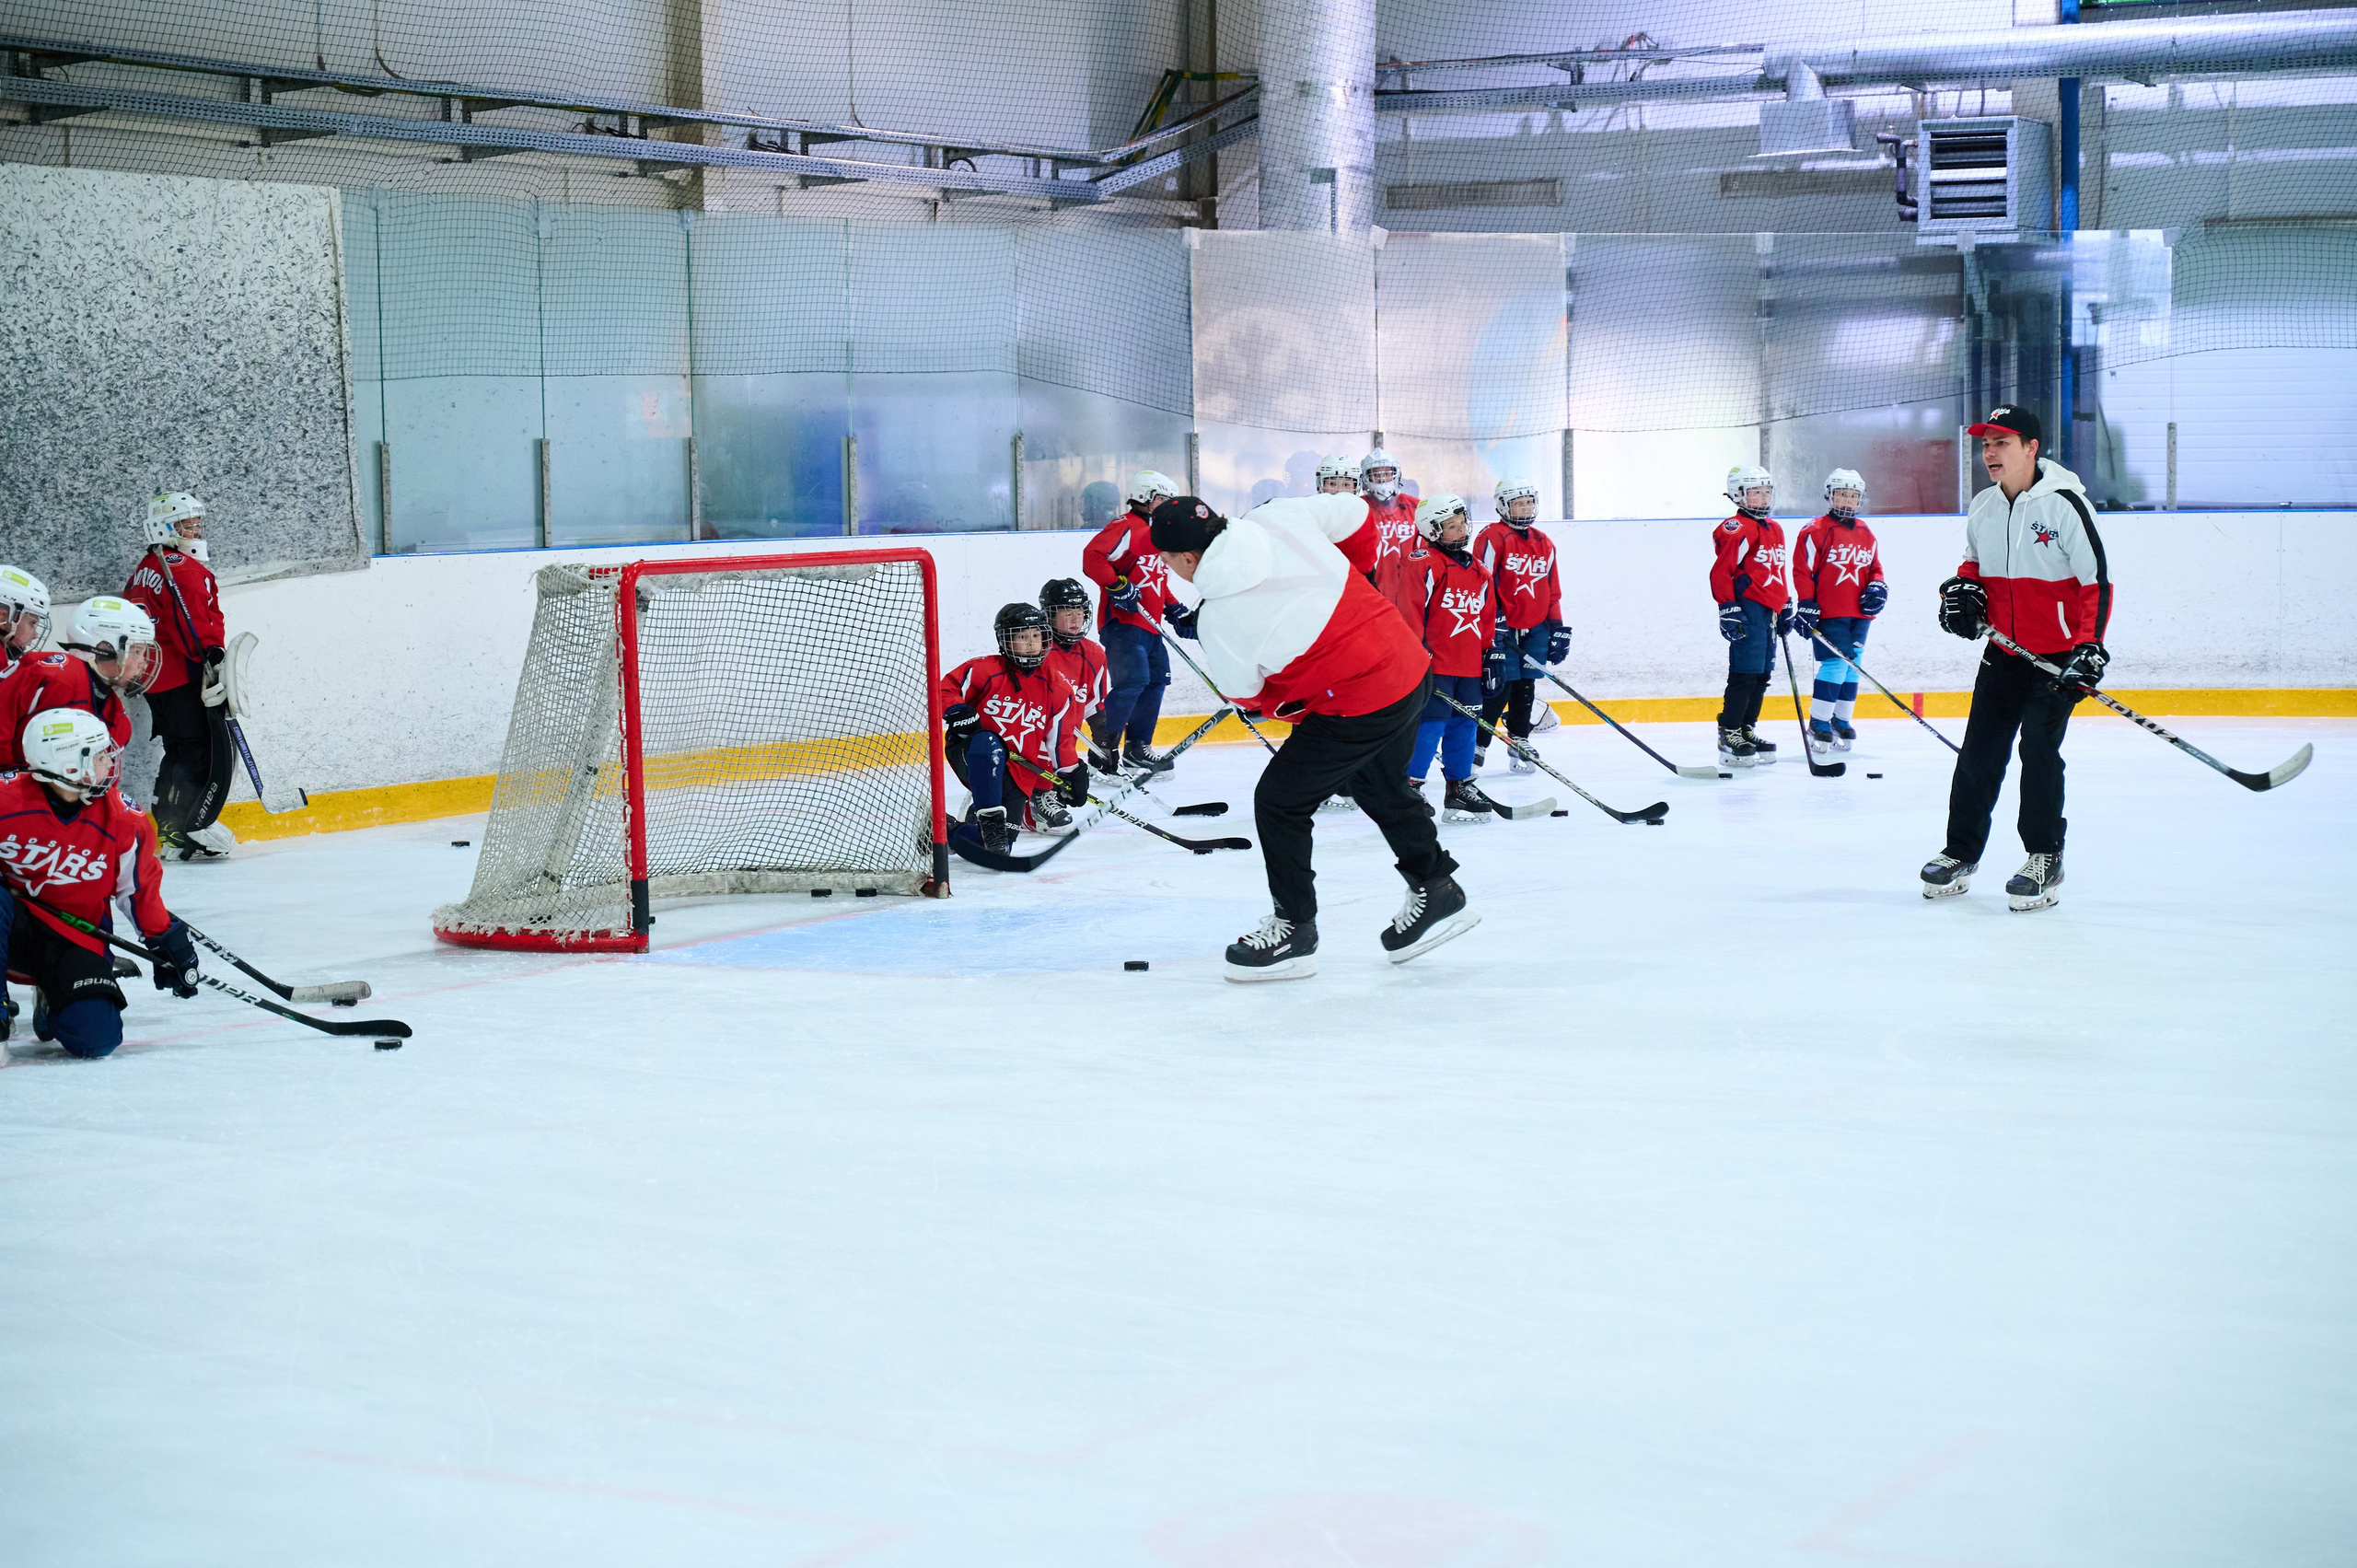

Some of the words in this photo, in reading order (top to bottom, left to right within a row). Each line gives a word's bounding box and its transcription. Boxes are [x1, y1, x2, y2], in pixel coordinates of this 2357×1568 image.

[1504, 556, 1548, 575] STAR
[952, 712, 981, 728] PRIM
[2094, 693, 2178, 743] SOYUZ
[0, 841, 109, 881] STARS
[6, 834, 108, 862] BOSTON
